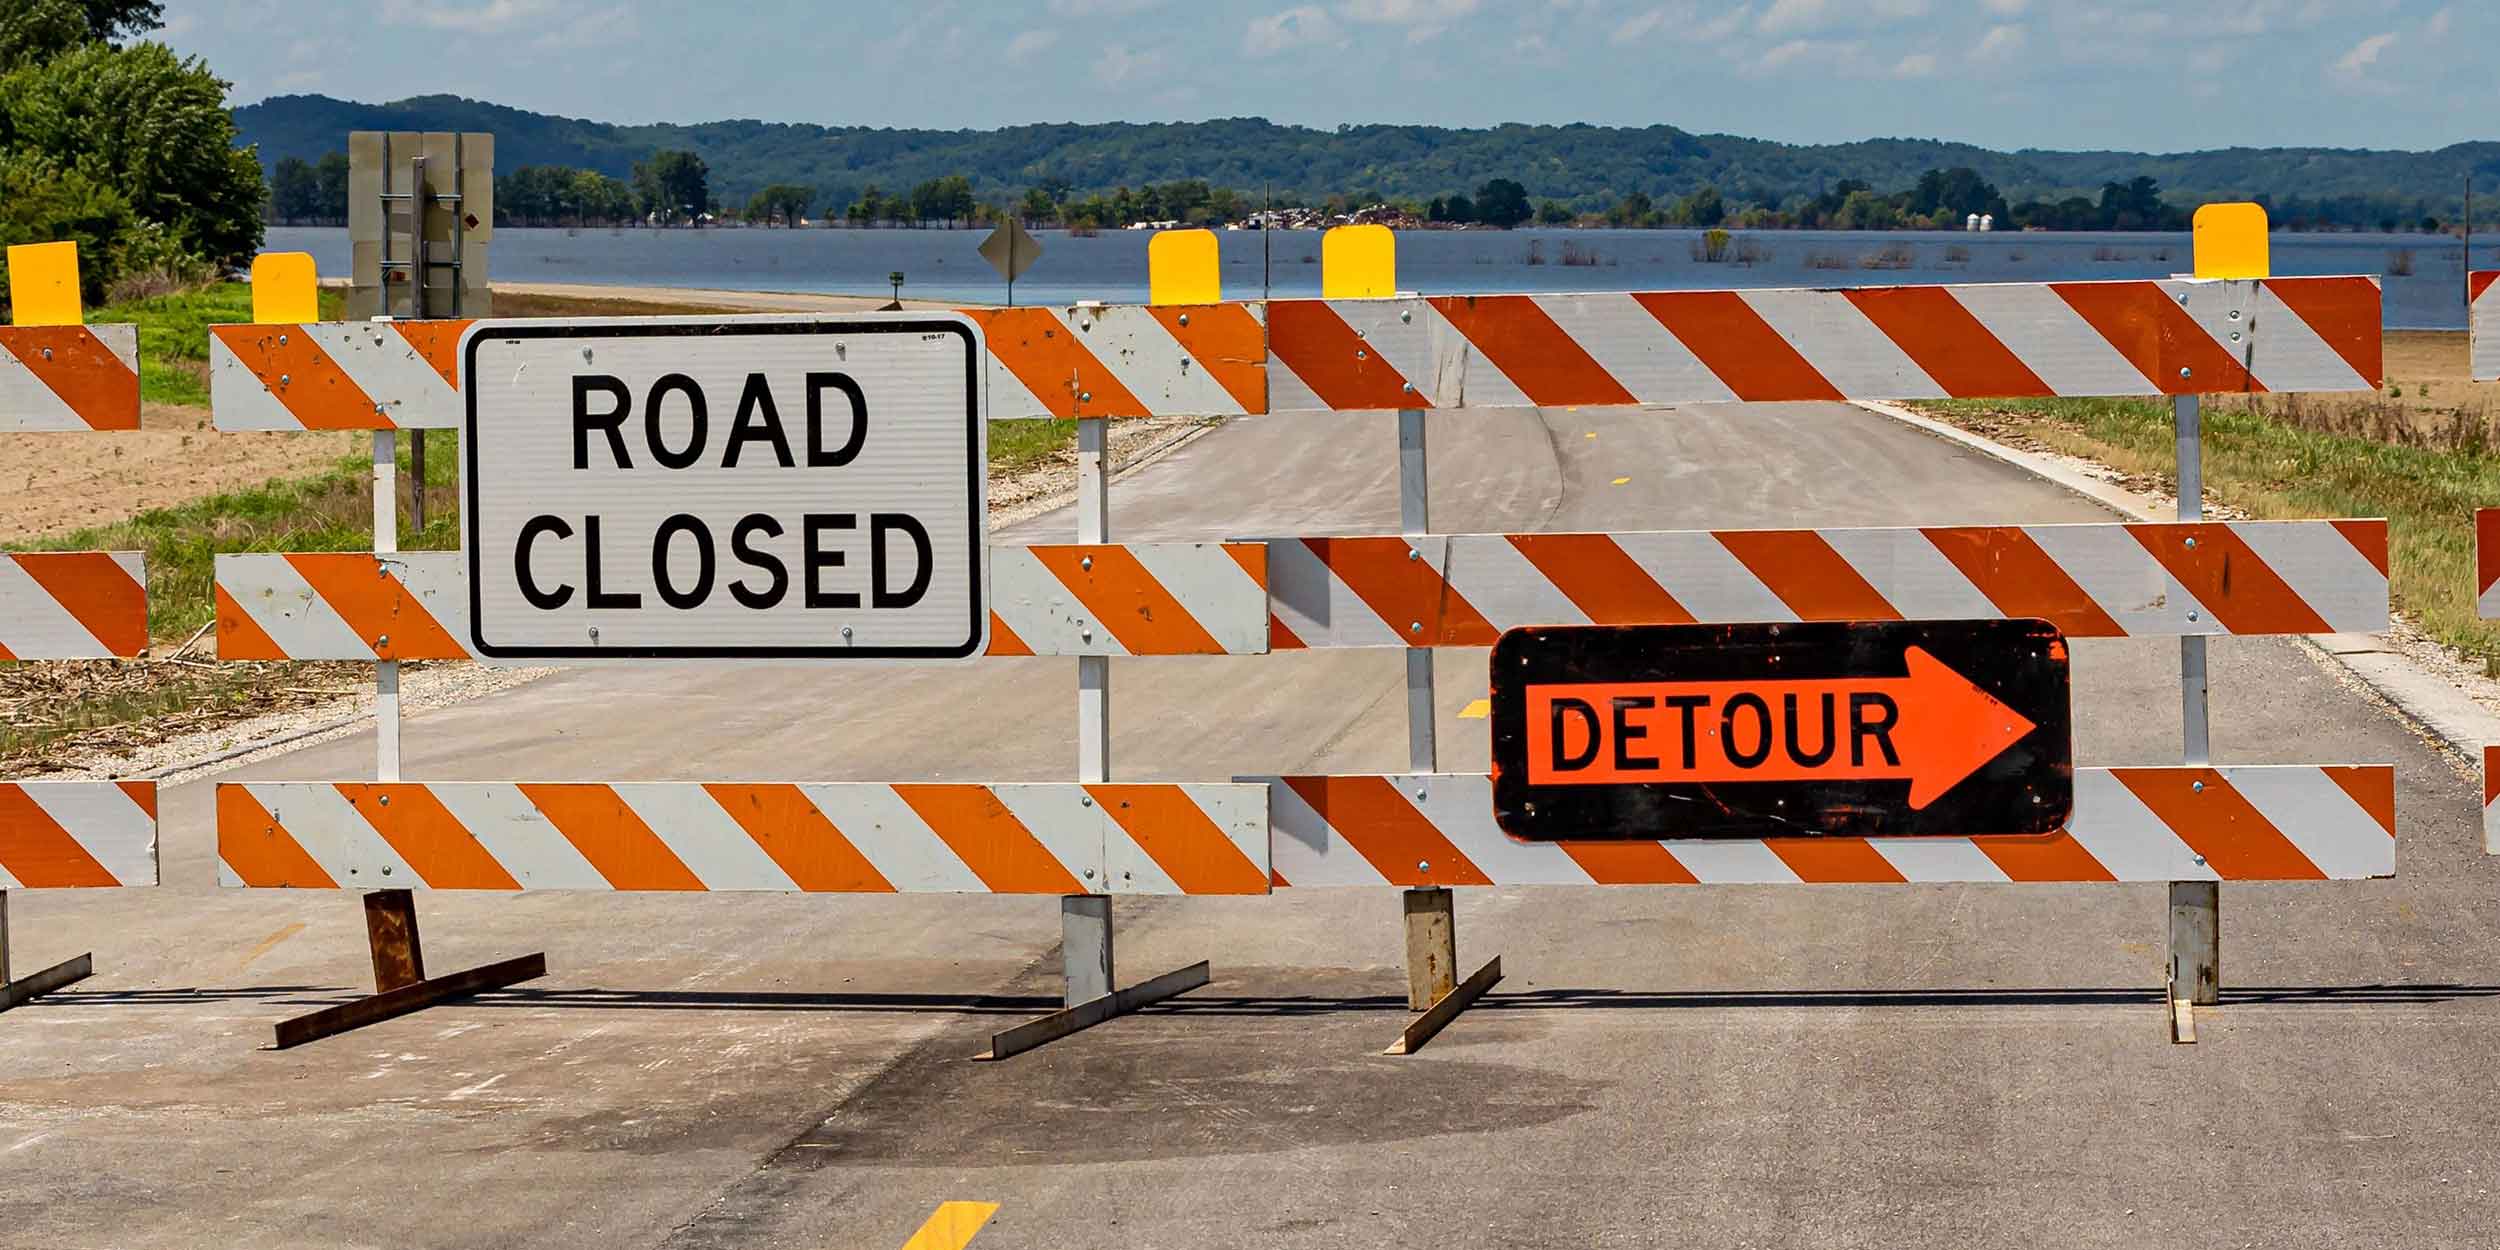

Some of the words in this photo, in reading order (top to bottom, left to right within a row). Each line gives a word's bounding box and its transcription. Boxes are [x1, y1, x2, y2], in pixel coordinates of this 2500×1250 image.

[572, 372, 869, 470] ROAD
[514, 512, 934, 611] CLOSED
[1550, 691, 1902, 773] DETOUR
